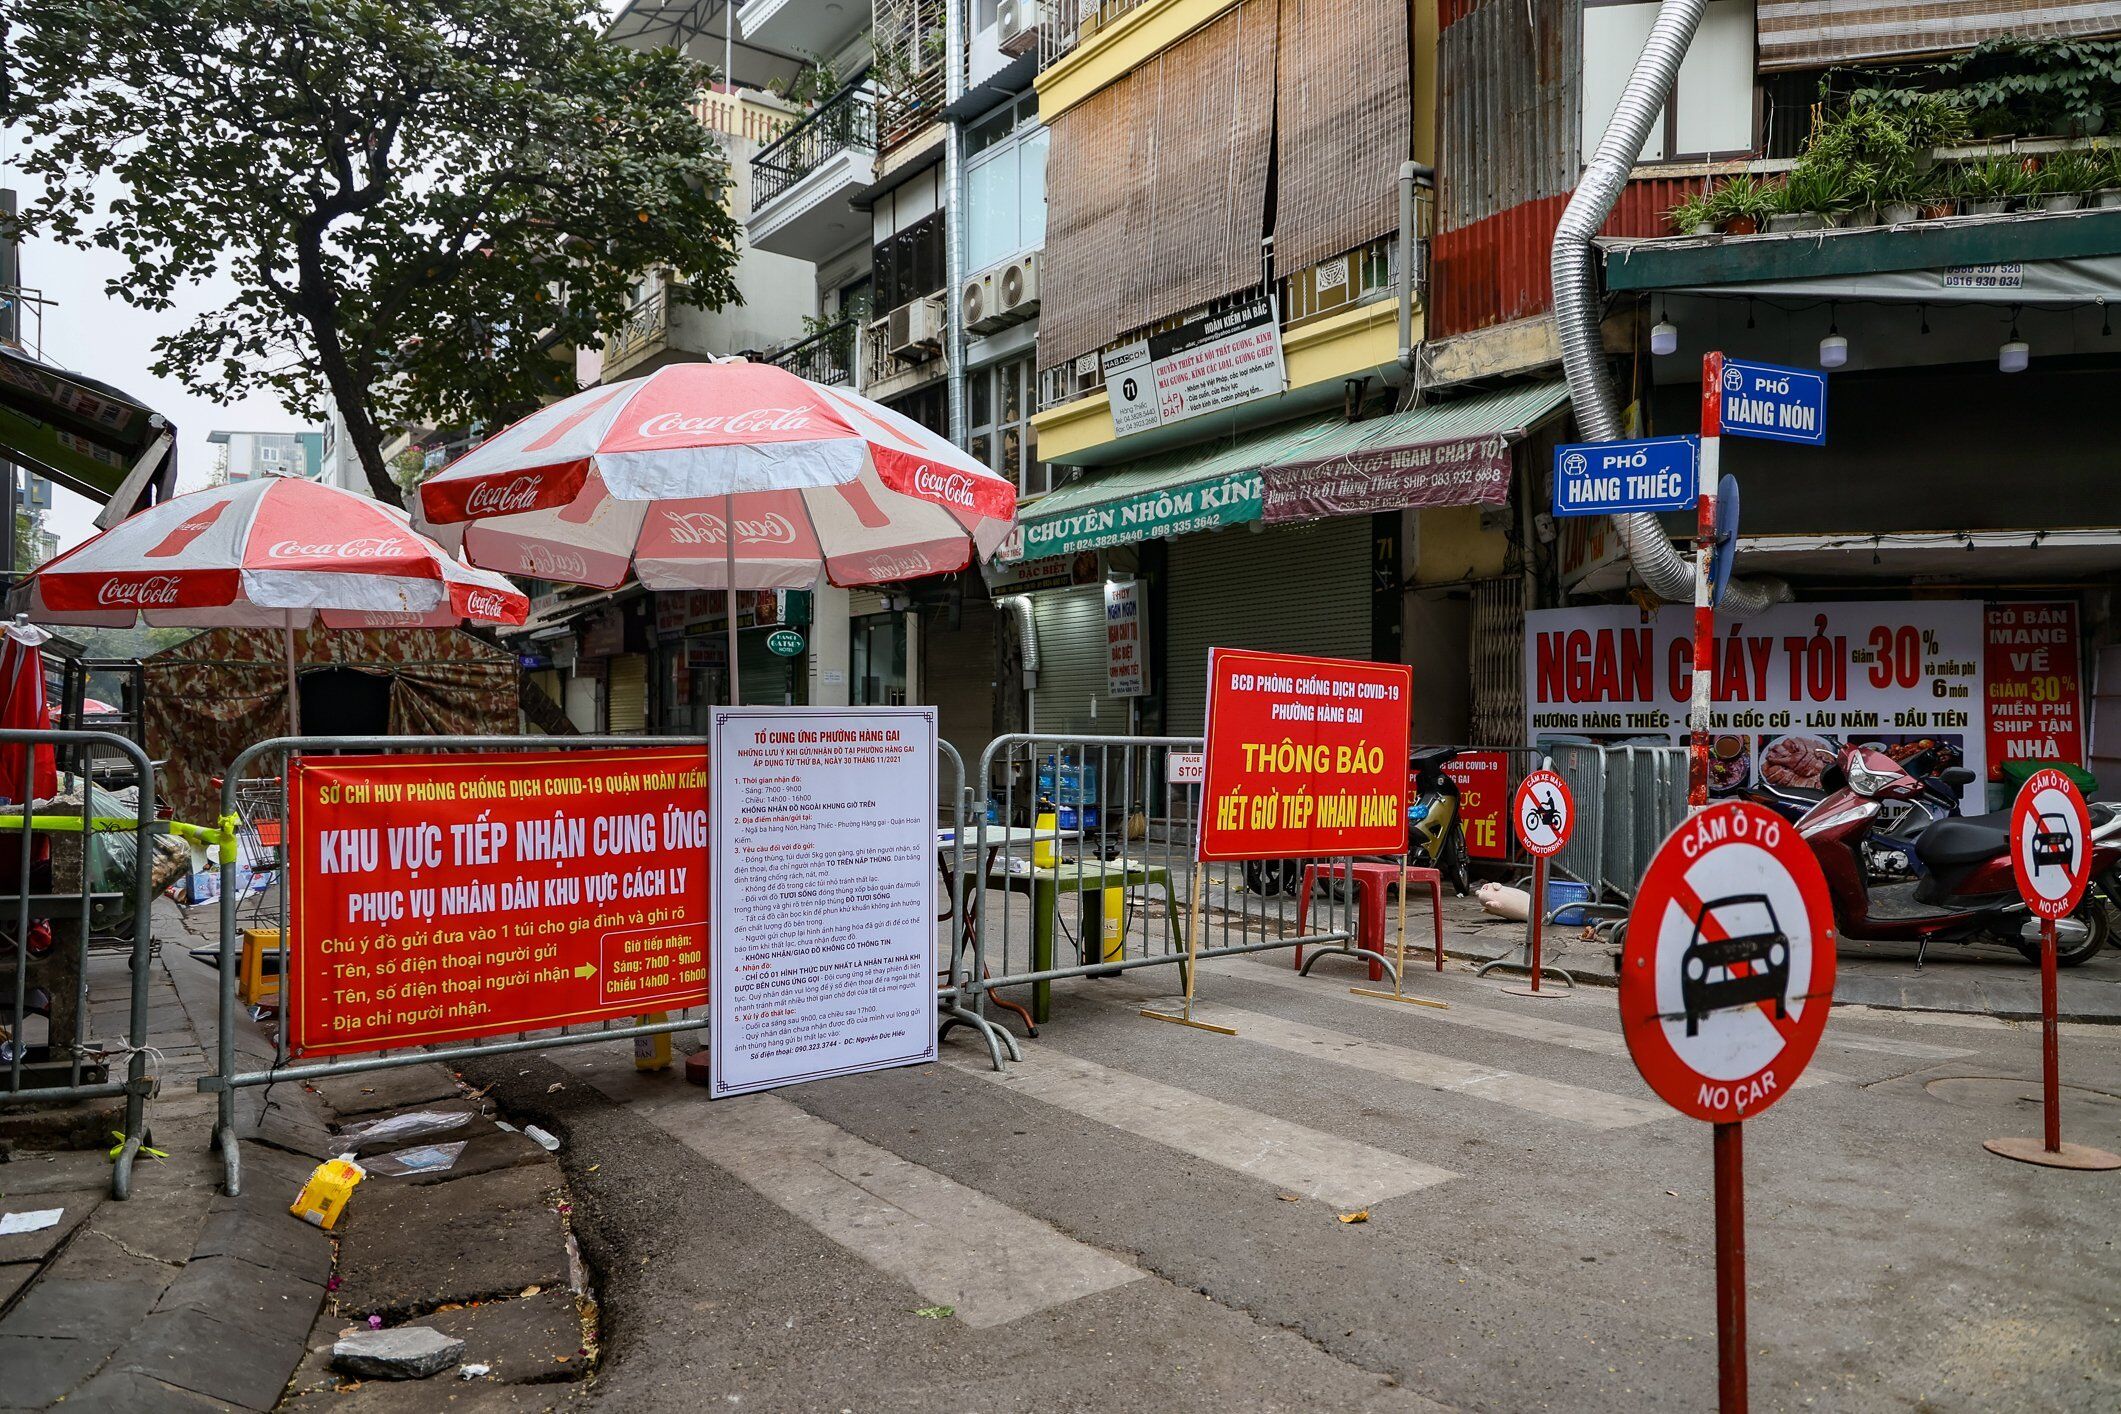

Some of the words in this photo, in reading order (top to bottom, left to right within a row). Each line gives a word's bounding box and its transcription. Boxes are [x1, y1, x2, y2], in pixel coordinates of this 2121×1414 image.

[1946, 277, 1972, 286] 0916
[1976, 277, 1996, 286] 930
[1999, 277, 2020, 286] 034
[1204, 319, 1222, 334] HOÀN
[1242, 307, 1252, 320] HÀ
[1125, 383, 1135, 397] 71
[1756, 377, 1790, 394] PHỐ
[638, 403, 817, 438] Coca-Cola
[1728, 393, 1774, 426] HÀNG
[1779, 400, 1814, 430] NÓN
[1603, 448, 1648, 469] PHỐ
[466, 475, 544, 515] Coca-Cola
[914, 464, 976, 506] Coca-Cola
[1568, 474, 1620, 503] HÀNG
[1627, 466, 1682, 499] THIẾC
[1028, 509, 1115, 542] CHUYÊN
[1121, 493, 1193, 526] NHÔM
[1151, 526, 1169, 537] 098
[1172, 521, 1191, 532] 335
[1194, 514, 1220, 529] 3642
[268, 538, 407, 560] Coca-Cola
[97, 576, 182, 606] Coca-Cola
[466, 590, 503, 619] Coca-Cola
[1988, 610, 2016, 625] CÓ
[2023, 608, 2067, 623] BÁN
[1989, 629, 2067, 643] MANG
[1536, 629, 1653, 703] NGAN
[1668, 623, 1774, 703] CÁY
[1784, 613, 1847, 702] TỎI
[1852, 649, 1874, 663] Giảm
[1868, 625, 1920, 689] 30
[1923, 630, 1939, 655] %
[1925, 663, 1935, 675] và
[1938, 661, 1959, 675] miễn
[1962, 661, 1976, 676] phí
[2010, 647, 2050, 672] VỀ
[1231, 674, 1254, 690] BCĐ
[1257, 673, 1292, 694] PHÒNG
[1296, 674, 1329, 696] CHỐNG
[1332, 682, 1355, 700] DỊCH
[1358, 683, 1399, 700] COVID-19
[1932, 679, 1946, 697] 6
[1949, 685, 1968, 697] món
[1989, 679, 2028, 697] GIẢM
[2031, 677, 2059, 701] 30
[1272, 700, 1314, 721] PHƯỜNG
[1317, 703, 1344, 722] HÀNG
[1346, 709, 1362, 723] GAI
[1533, 713, 1578, 728] HƯƠNG
[1582, 710, 1622, 728] HÀNG
[1626, 708, 1670, 728] THIẾC
[1733, 708, 1766, 728] GỐC
[1769, 710, 1790, 728] CŨ
[1806, 710, 1836, 727] LÂU
[1841, 710, 1878, 727] NĂM
[1894, 709, 1927, 727] ĐẦU
[1932, 710, 1968, 726] TIÊN
[1992, 700, 2037, 715] MIỄN
[2043, 700, 2071, 715] PHÍ
[755, 728, 767, 743] TỔ
[770, 732, 795, 743] CUNG
[798, 730, 817, 743] ỨNG
[820, 729, 856, 742] PHƯỜNG
[859, 730, 883, 742] HÀNG
[886, 730, 900, 741] GAI
[1993, 721, 2033, 732] SHIP
[2038, 720, 2072, 734] TẬN
[1242, 737, 1330, 773] THÔNG
[1336, 740, 1384, 774] BÁO
[2007, 738, 2060, 758] NHÀ
[1448, 761, 1464, 771] DỊCH
[1465, 762, 1497, 770] COVID-19
[320, 778, 340, 804] SỞ
[345, 779, 370, 803] CHỈ
[375, 785, 402, 802] HUY
[408, 780, 455, 800] PHÒNG
[459, 774, 506, 798] CHỐNG
[510, 778, 541, 800] DỊCH
[544, 777, 602, 796] COVID-19
[605, 771, 640, 795] QUẬN
[643, 770, 676, 791] HOÀN
[679, 768, 707, 789] KIẾM
[1458, 775, 1469, 784] GAI
[1527, 775, 1539, 787] CẤM
[2031, 774, 2049, 793] CẤM
[2060, 778, 2070, 793] TÔ
[1217, 784, 1248, 830] HẾT
[1251, 788, 1279, 830] GIỜ
[1282, 784, 1314, 829] TIẾP
[1317, 788, 1356, 835] NHẬN
[1360, 788, 1398, 826] HÀNG
[320, 829, 378, 874] KHU
[387, 821, 442, 878] VỰC
[451, 809, 508, 866] TIẾP
[516, 810, 585, 867] NHẬN
[593, 814, 655, 855] CUNG
[662, 803, 707, 849] ỨNG
[1475, 811, 1499, 847] TẾ
[1682, 815, 1727, 858] CẤM
[1733, 810, 1748, 836] Ô
[1755, 819, 1780, 848] TÔ
[1523, 837, 1531, 847] NO
[1532, 837, 1564, 853] MOTORBIKE
[349, 891, 403, 927] PHỤC
[409, 887, 435, 923] VỤ
[441, 879, 496, 916] NHÂN
[501, 875, 539, 911] DÂN
[544, 878, 579, 907] KHU
[585, 872, 618, 907] VỰC
[622, 866, 664, 899] CÁCH
[669, 868, 687, 893] LY
[2039, 900, 2050, 912] NO
[2052, 899, 2068, 912] CAR
[321, 937, 355, 954] Chú
[359, 937, 368, 954] ý
[374, 932, 396, 950] đồ
[402, 930, 428, 950] gửi
[432, 928, 464, 946] đưa
[469, 927, 496, 941] vào
[501, 926, 508, 938] 1
[514, 919, 534, 937] túi
[538, 919, 565, 934] cho
[569, 916, 590, 934] gia
[594, 909, 624, 928] đình
[629, 909, 643, 924] và
[648, 910, 668, 926] ghi
[672, 906, 685, 920] rõ
[1697, 1083, 1729, 1109] NO
[1734, 1071, 1777, 1108] CAR
